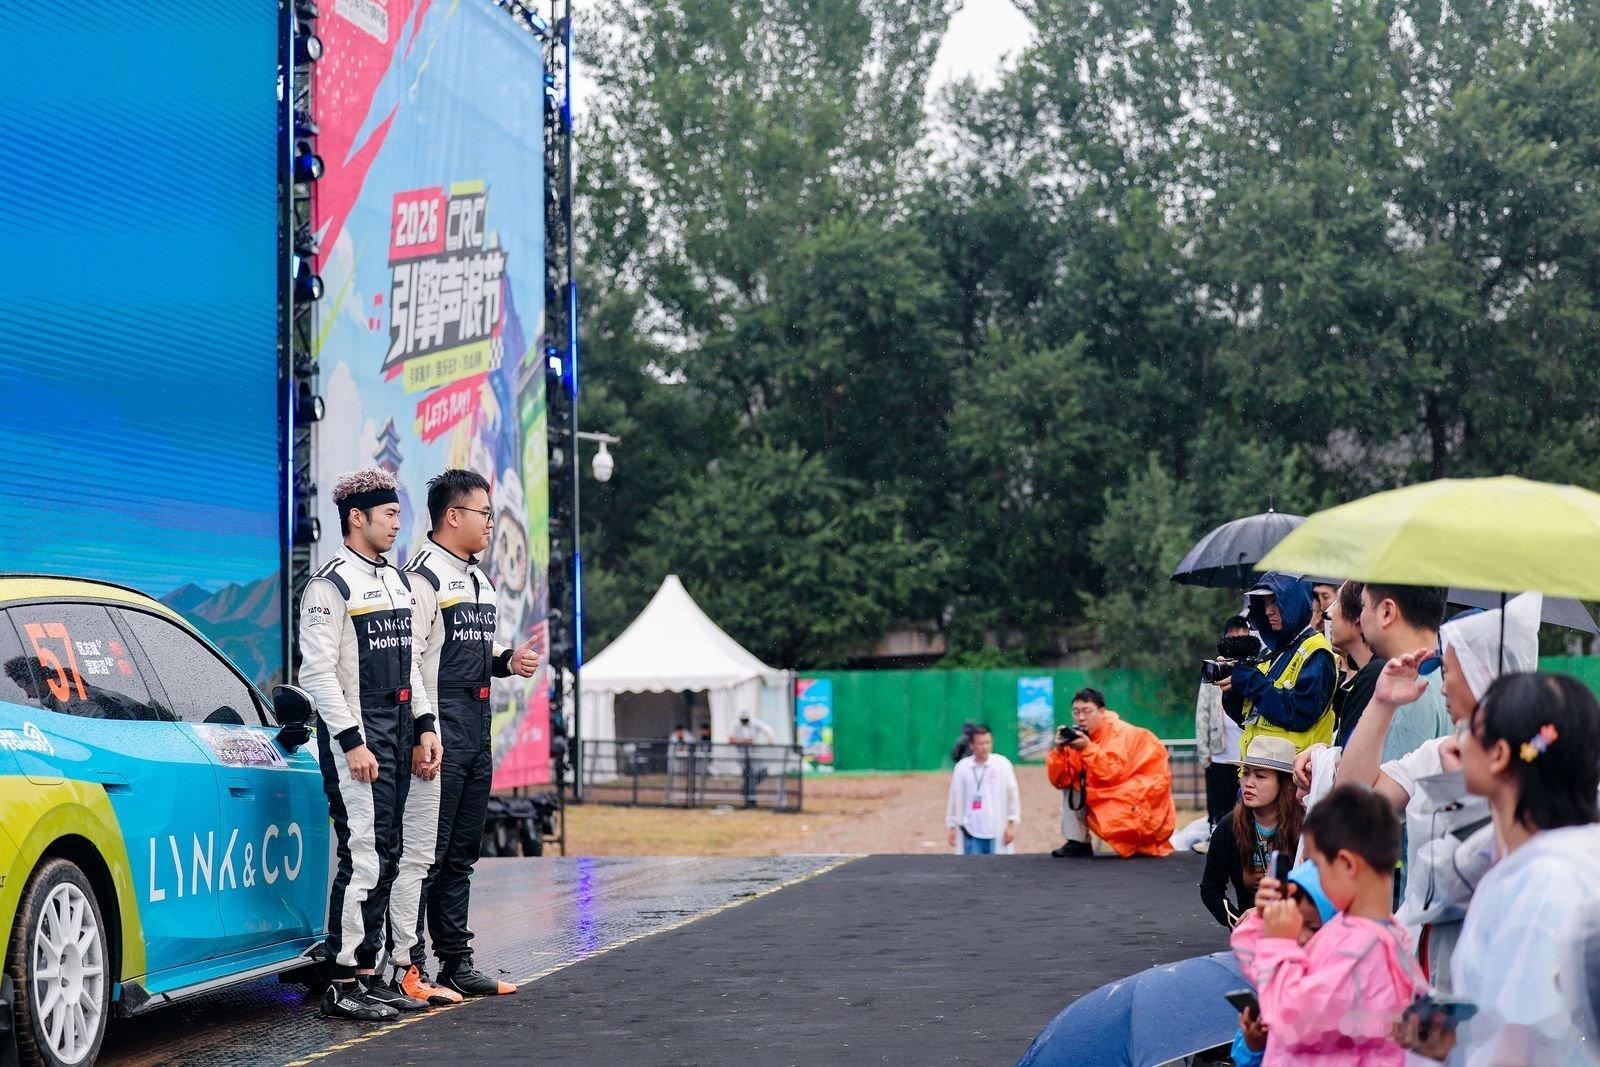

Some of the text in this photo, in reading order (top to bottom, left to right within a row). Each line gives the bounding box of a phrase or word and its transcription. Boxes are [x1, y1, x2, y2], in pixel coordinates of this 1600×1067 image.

[396, 196, 486, 251] 2026 CRC
[386, 252, 505, 363] 引擎声波节
[308, 606, 322, 614] YATO
[24, 622, 88, 702] 57
